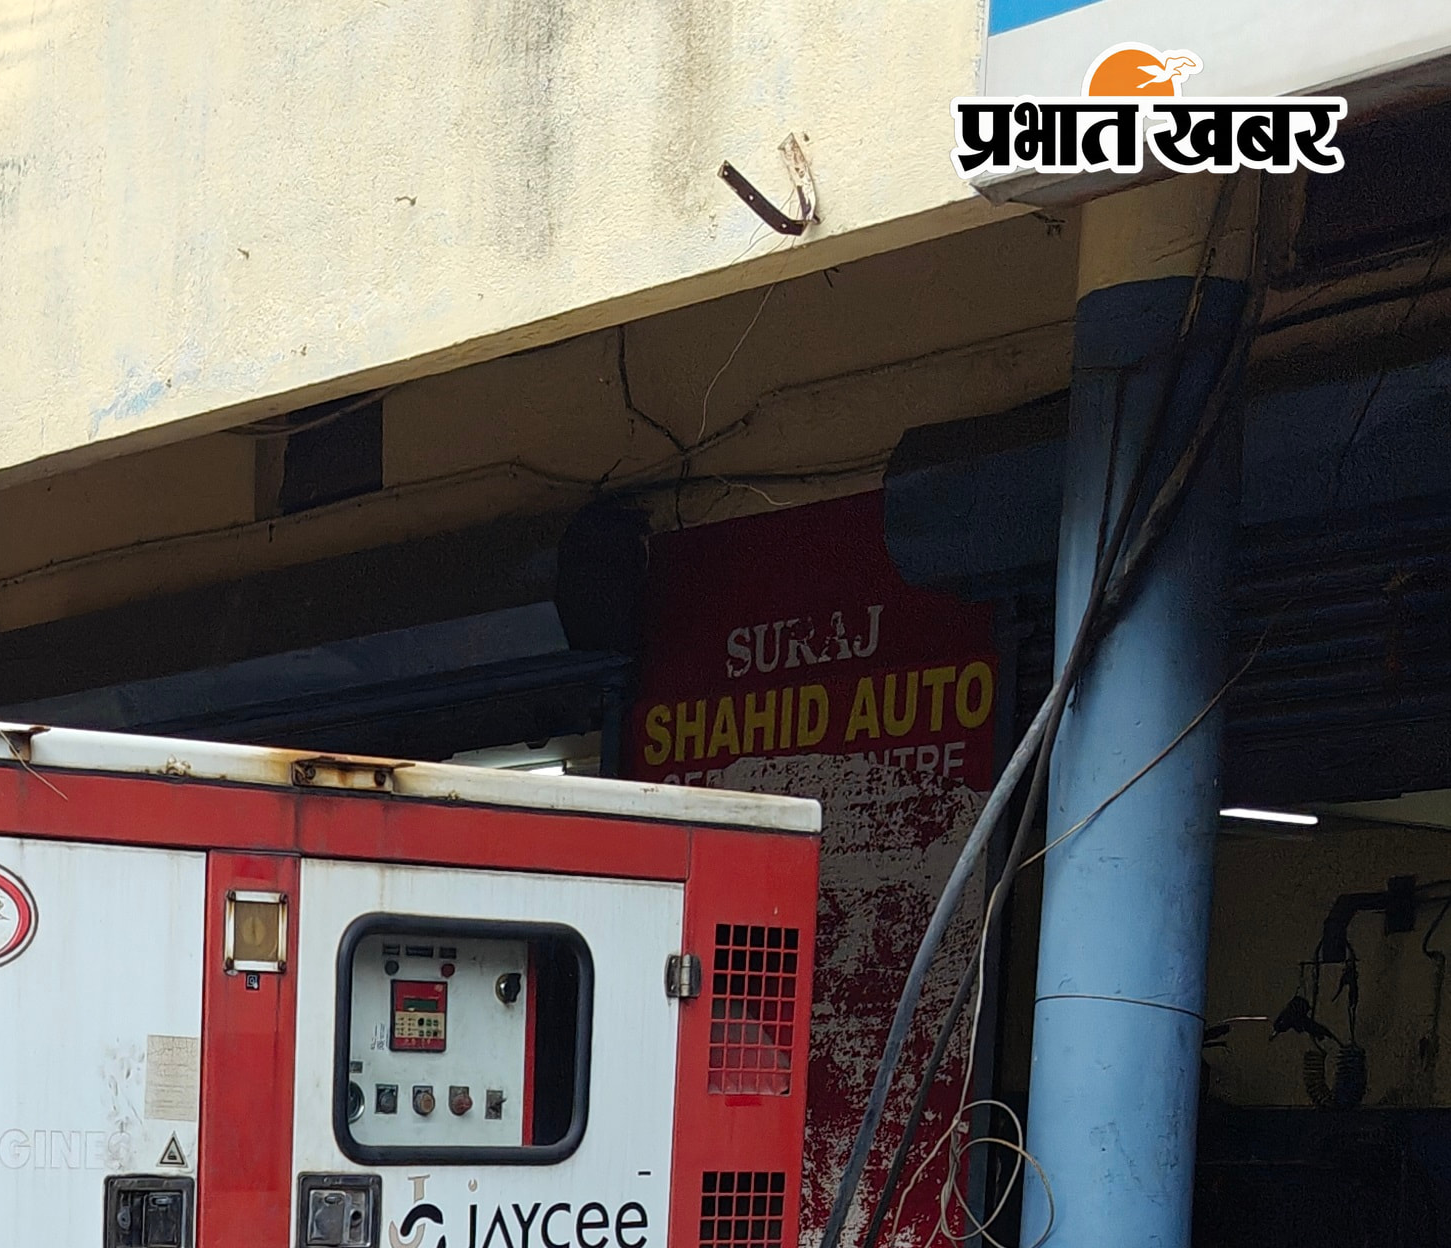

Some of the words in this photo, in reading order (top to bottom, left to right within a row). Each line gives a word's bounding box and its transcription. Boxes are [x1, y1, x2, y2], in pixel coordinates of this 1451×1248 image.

[725, 604, 885, 679] SURAJ
[644, 684, 830, 767] SHAHID
[845, 660, 994, 743] AUTO
